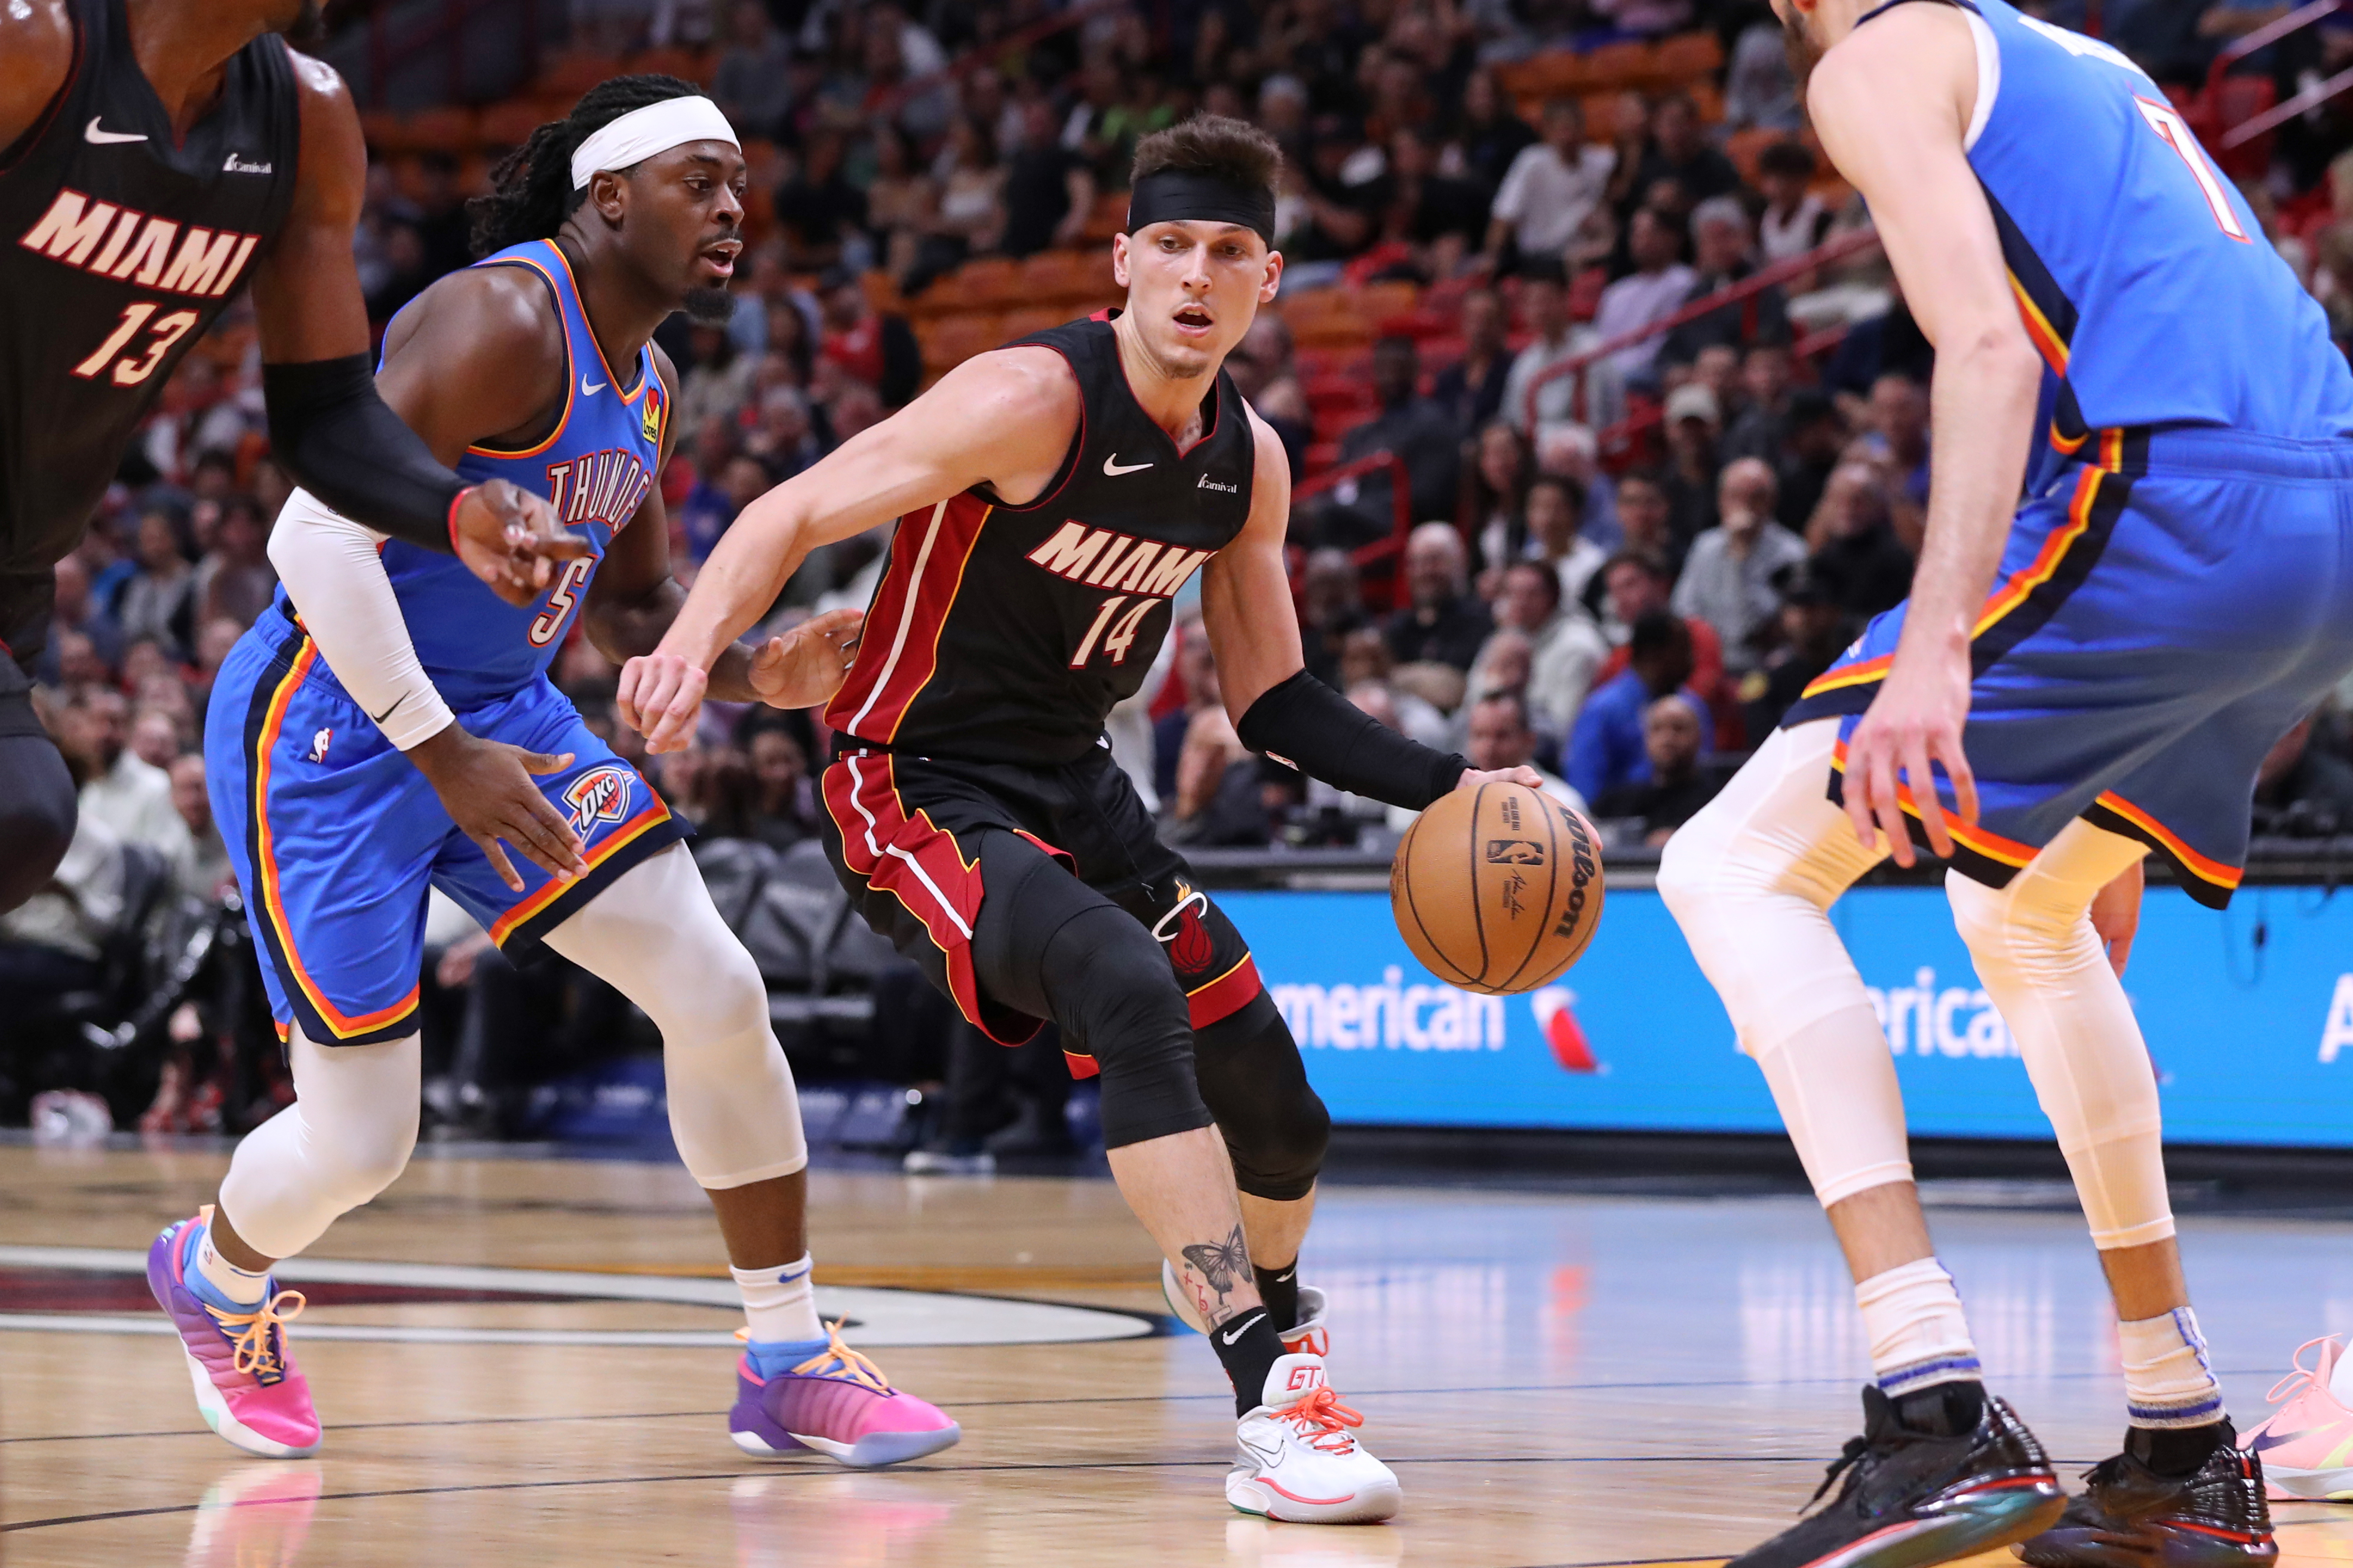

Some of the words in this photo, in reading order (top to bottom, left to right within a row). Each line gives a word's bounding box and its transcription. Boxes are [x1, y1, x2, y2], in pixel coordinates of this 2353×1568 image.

[2130, 93, 2251, 243] 7
[19, 186, 262, 297] MIAMI
[70, 302, 200, 386] 13
[547, 448, 652, 536] THUNDE
[1202, 479, 1238, 494] Carnival
[528, 552, 599, 647] 5
[1024, 518, 1219, 598] MIAM
[1068, 595, 1164, 669] 14
[580, 774, 615, 828] OKC
[1553, 806, 1596, 940] Wilson
[1258, 964, 1506, 1052] merican
